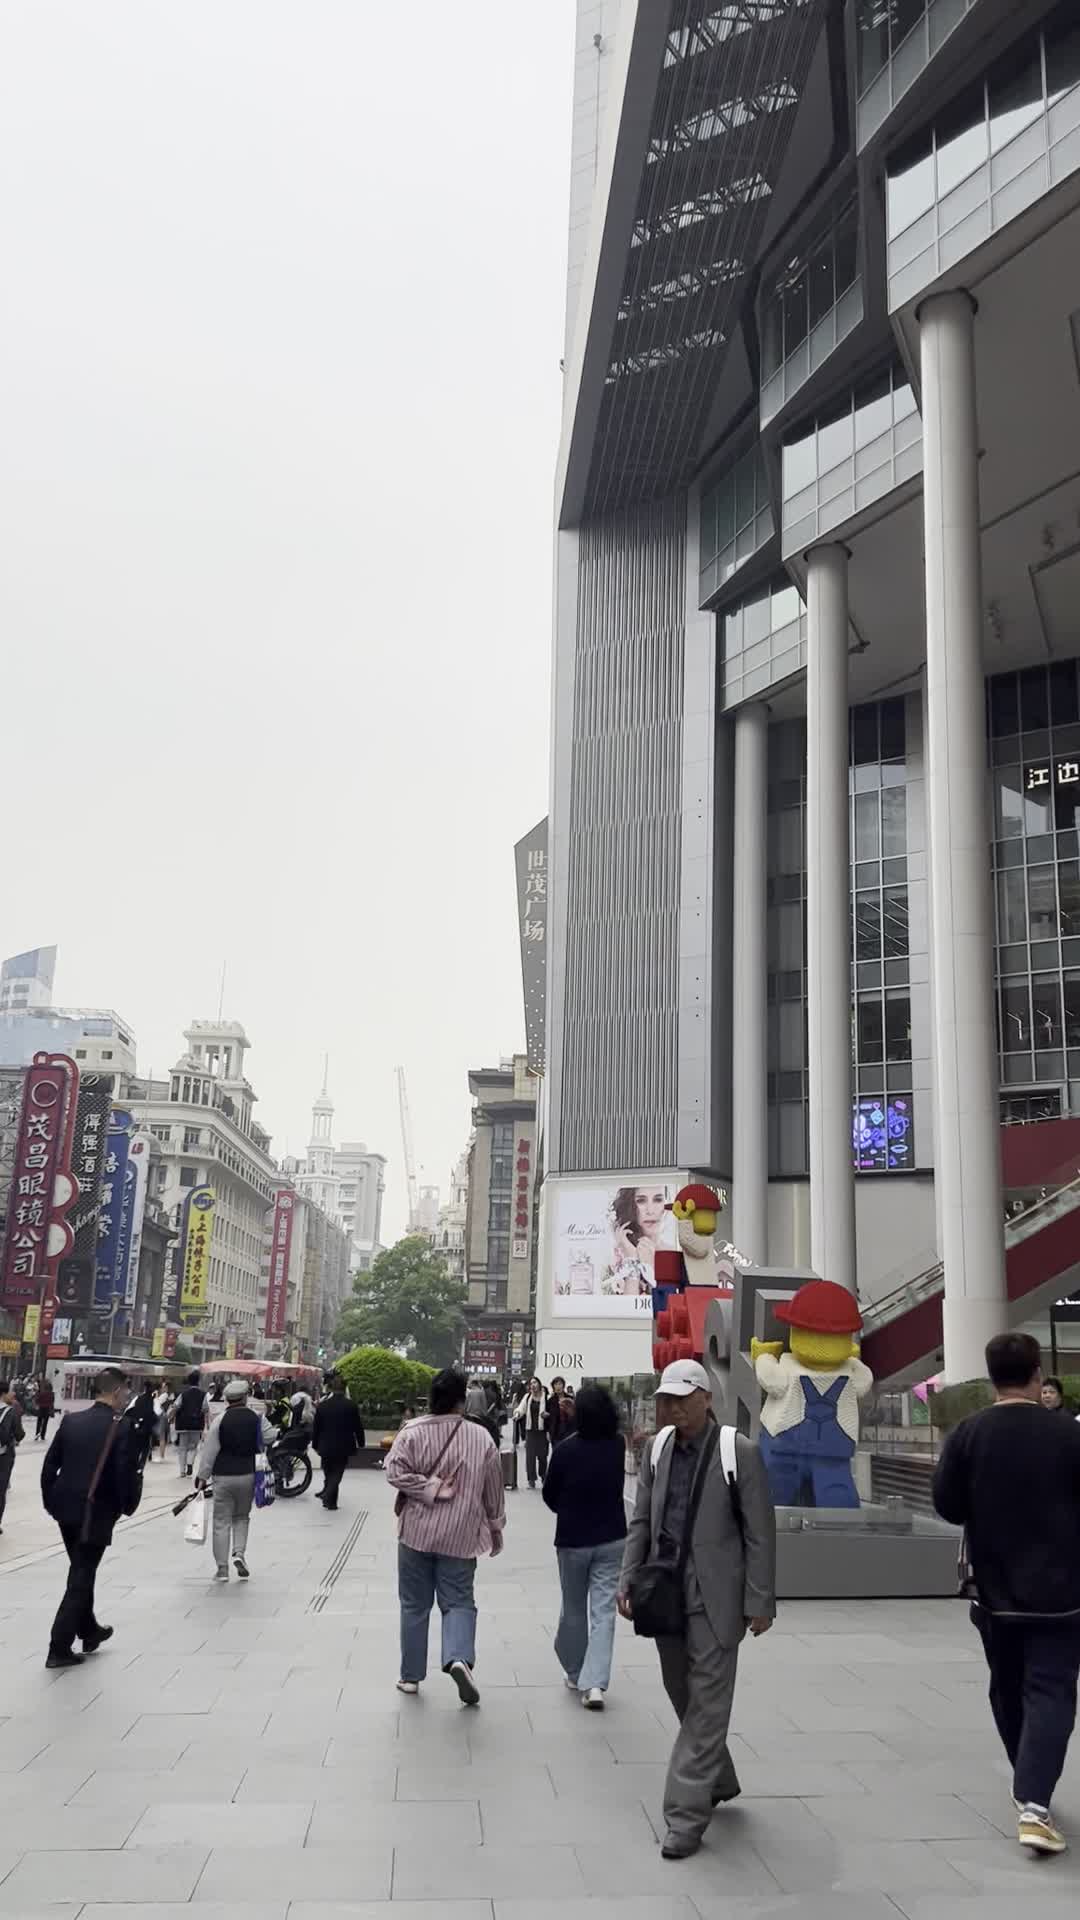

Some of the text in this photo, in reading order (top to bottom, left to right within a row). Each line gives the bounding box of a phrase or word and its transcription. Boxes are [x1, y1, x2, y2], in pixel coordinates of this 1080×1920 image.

[523, 849, 547, 941] 世茂广场
[12, 1114, 53, 1277] 茂昌眼镜公司
[544, 1352, 584, 1369] DIOR
